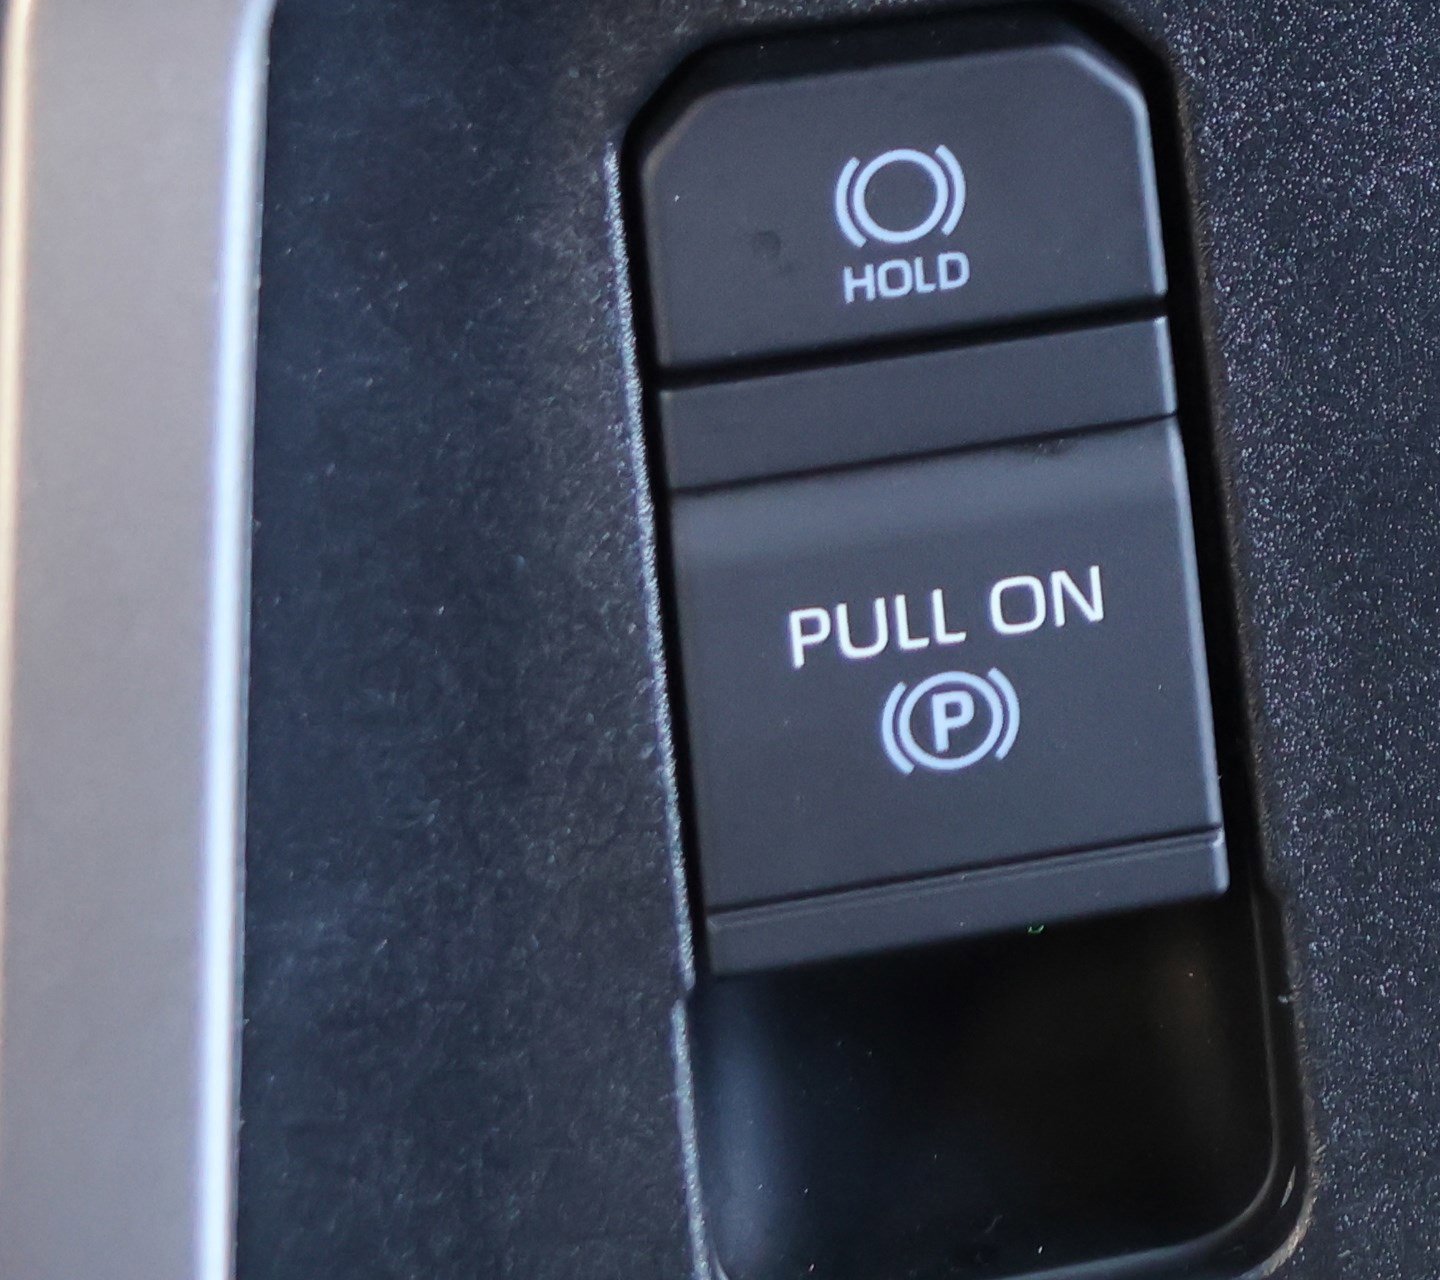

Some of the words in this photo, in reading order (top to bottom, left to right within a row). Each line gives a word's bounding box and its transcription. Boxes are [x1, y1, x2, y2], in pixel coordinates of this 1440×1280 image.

[843, 256, 971, 303] HOLD
[788, 588, 968, 669] PULL
[989, 565, 1106, 636] ON
